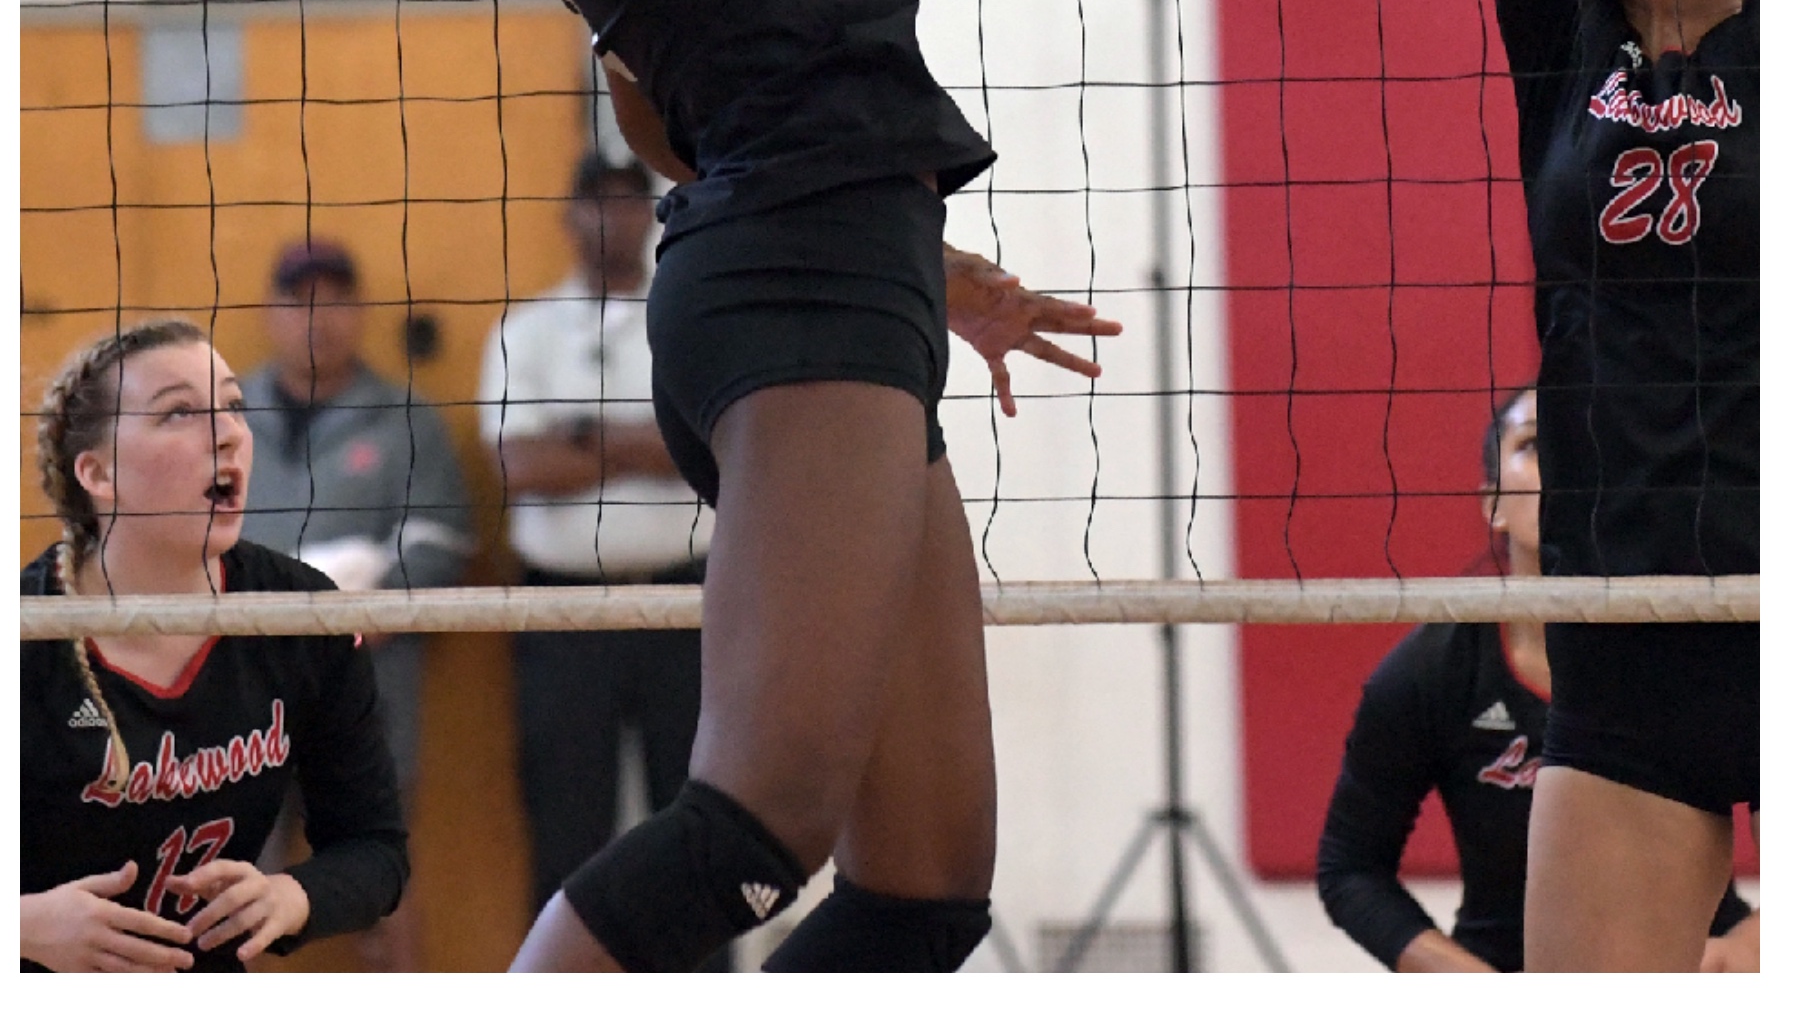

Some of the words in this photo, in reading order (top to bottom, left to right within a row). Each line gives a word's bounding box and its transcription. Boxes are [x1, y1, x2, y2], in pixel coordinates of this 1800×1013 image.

[1598, 139, 1719, 245] 28
[81, 698, 291, 808] Lakewood
[145, 817, 235, 916] 17
